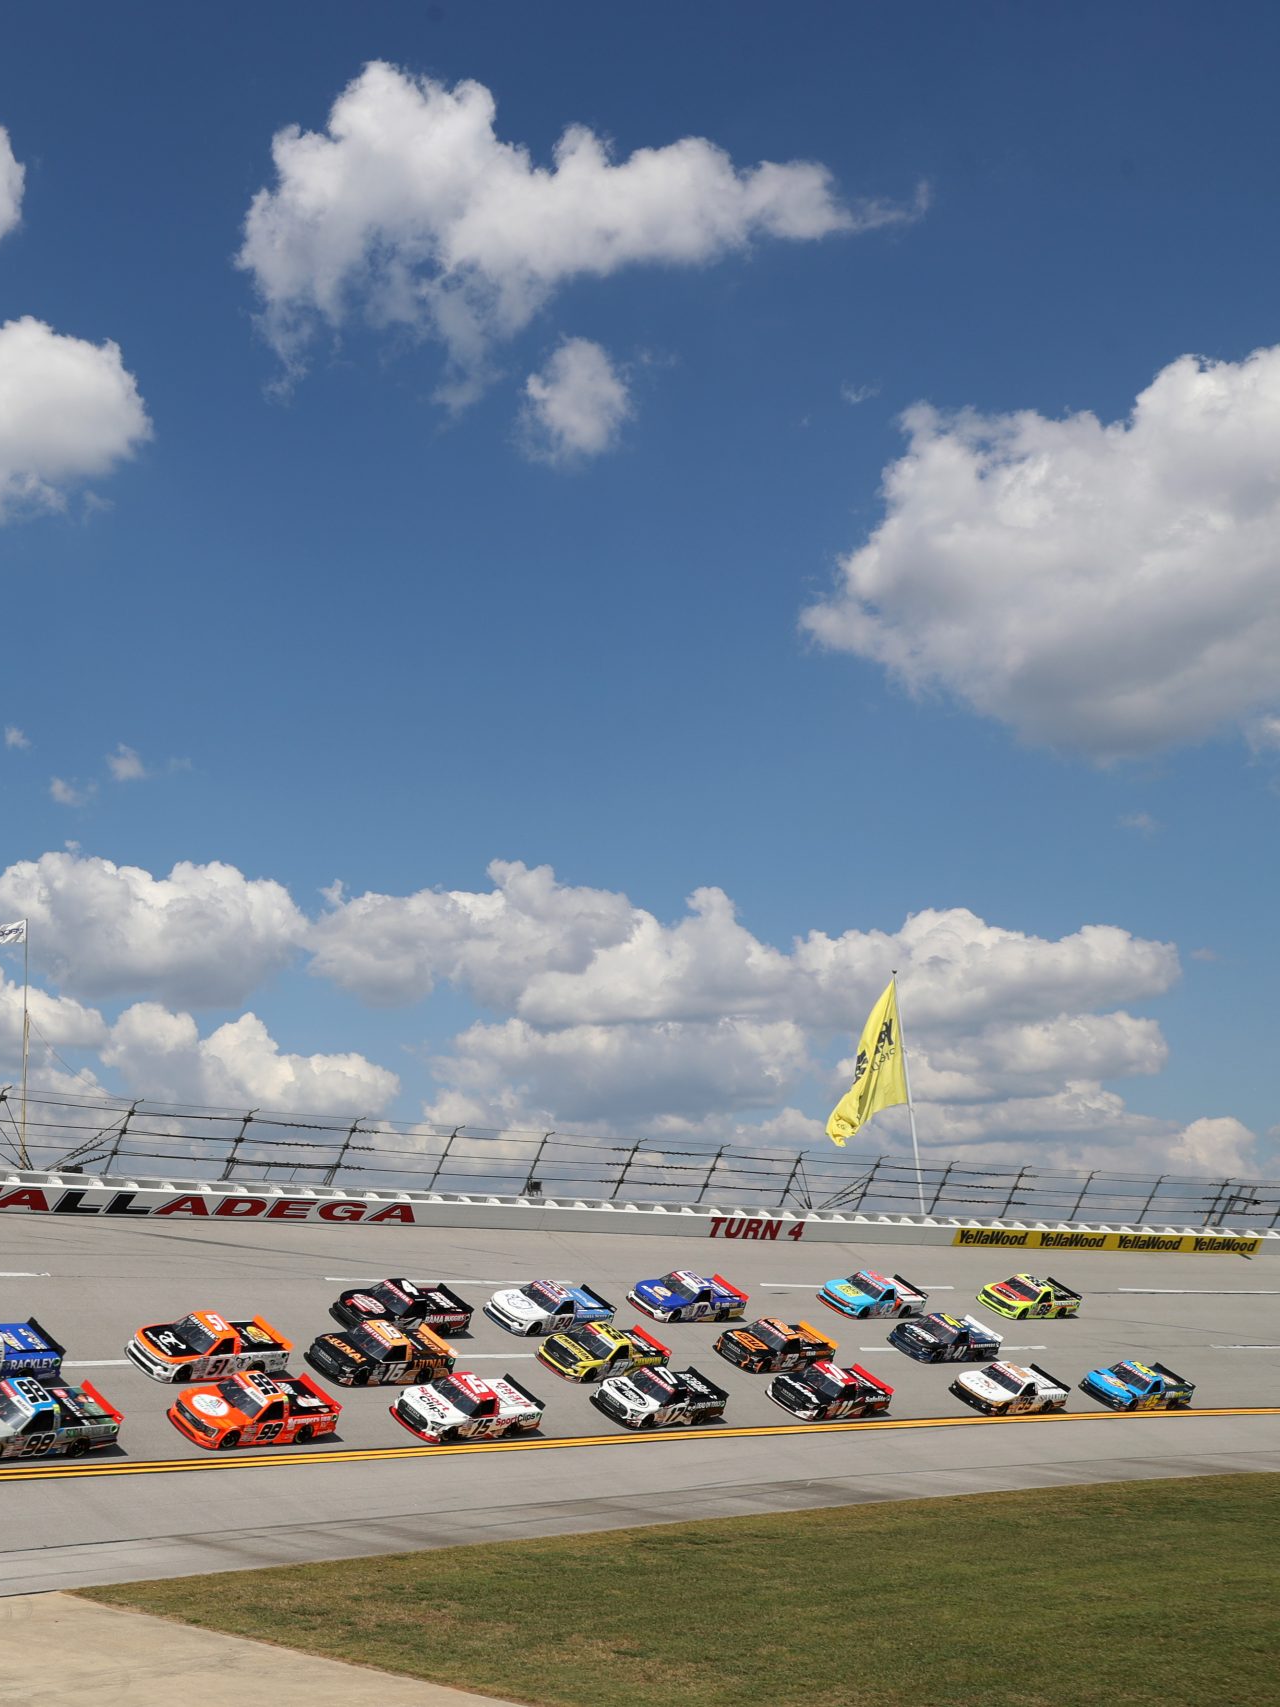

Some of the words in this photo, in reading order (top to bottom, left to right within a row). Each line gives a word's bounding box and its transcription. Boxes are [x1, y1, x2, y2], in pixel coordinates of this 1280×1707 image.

[709, 1217, 783, 1240] TURN
[788, 1221, 805, 1241] 4
[958, 1230, 1028, 1246] YellaWood
[1039, 1233, 1106, 1248] YellaWood
[1118, 1235, 1184, 1250] YellaWood
[1193, 1237, 1259, 1252] YellaWood
[384, 1280, 413, 1305] CRAFTSMAN
[401, 1280, 419, 1295] 4
[532, 1281, 560, 1304] CRAFTSMAN
[693, 1304, 708, 1317] 19
[189, 1314, 219, 1341] CRAFTSMAN
[205, 1314, 229, 1331] 51
[375, 1322, 402, 1339] 16
[553, 1316, 573, 1331] 24
[361, 1323, 393, 1349] CRAFTSMAN
[558, 1334, 593, 1359] CHAMPION
[952, 1345, 967, 1359] 41
[10, 1358, 55, 1370] RACKLEY
[207, 1359, 230, 1375] 51
[783, 1354, 800, 1367] 52
[383, 1363, 407, 1381] 16
[640, 1366, 675, 1394] CRAFTSMAN
[654, 1366, 678, 1384] 17
[824, 1363, 848, 1380] 11
[992, 1364, 1025, 1386] CRAFTSMAN
[14, 1379, 51, 1404] 98
[248, 1373, 279, 1395] 99
[448, 1375, 481, 1404] CRAFTSMAN
[461, 1375, 489, 1394] 15
[418, 1386, 450, 1412] Sport
[419, 1395, 447, 1419] Clips
[837, 1399, 854, 1415] 11
[864, 1395, 887, 1403] Safelite
[405, 1404, 421, 1418] TOYOTA
[665, 1405, 687, 1423] 17
[255, 1422, 284, 1441] 99
[471, 1418, 493, 1435] 15
[19, 1433, 57, 1456] 98
